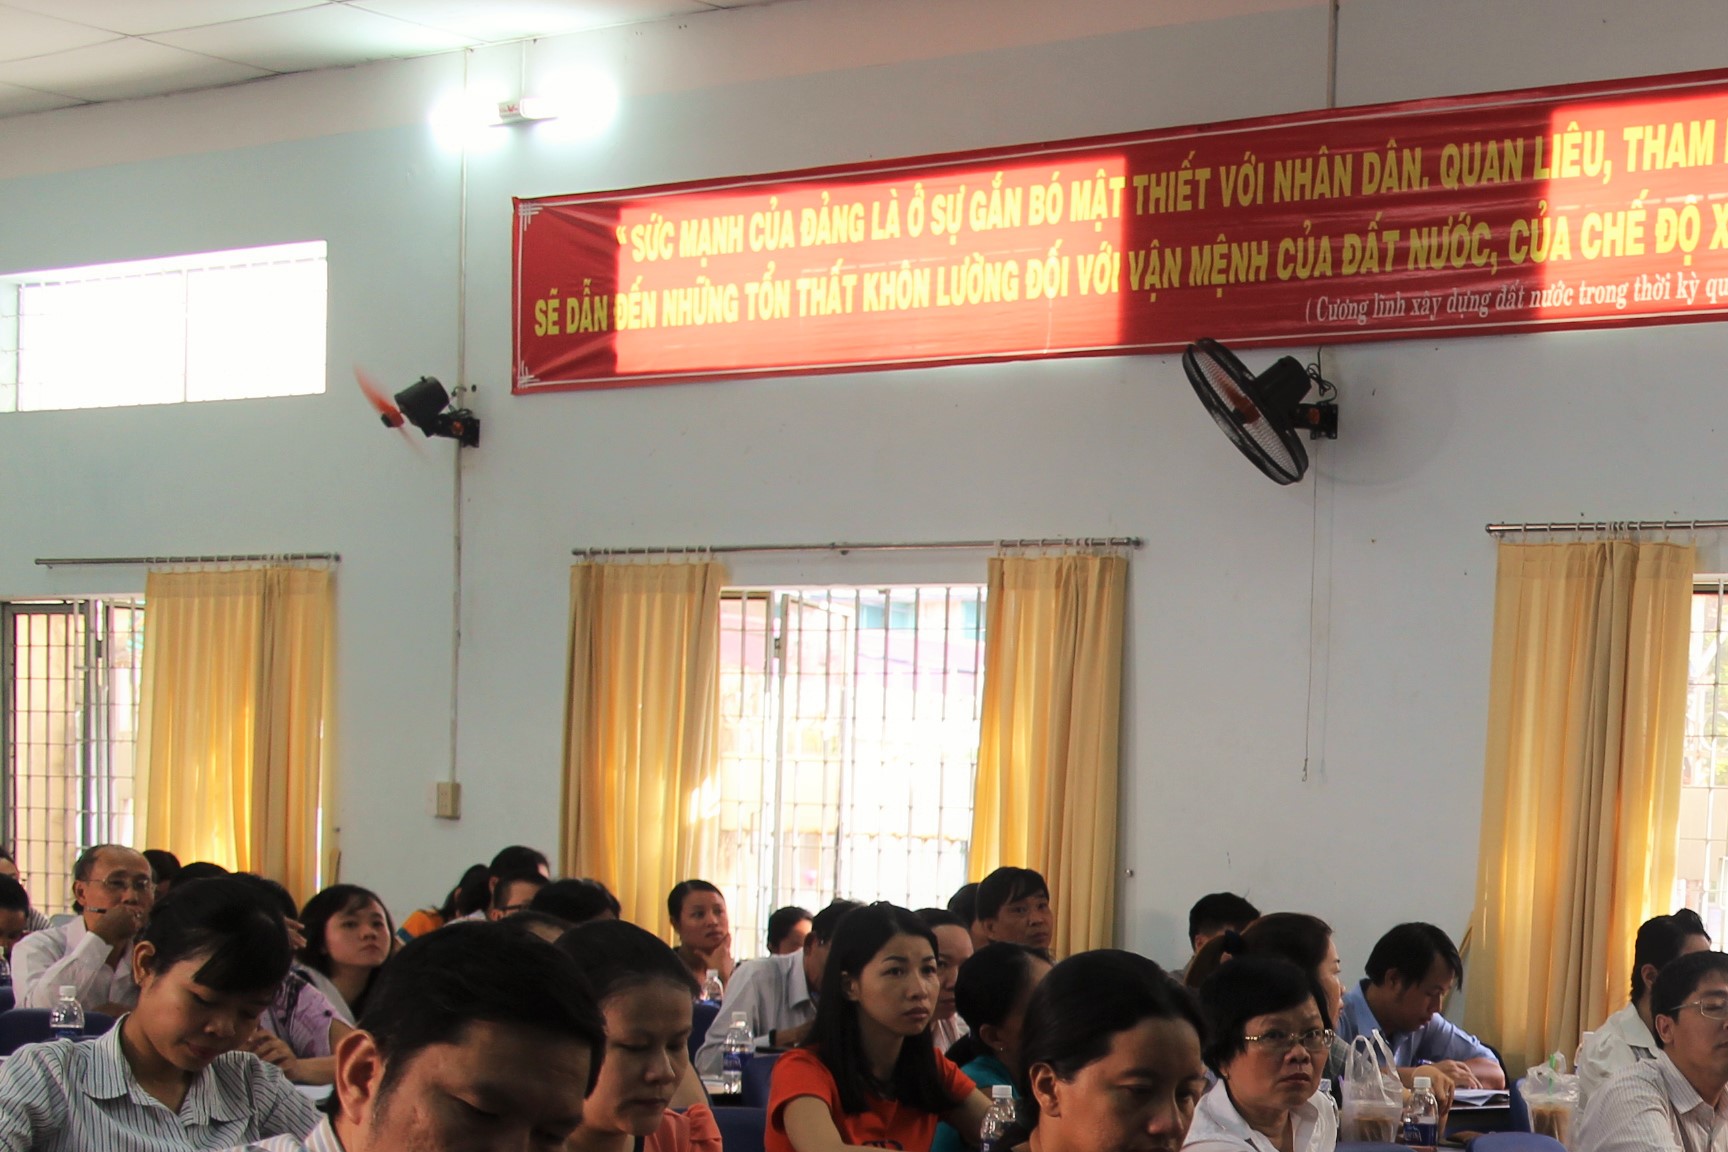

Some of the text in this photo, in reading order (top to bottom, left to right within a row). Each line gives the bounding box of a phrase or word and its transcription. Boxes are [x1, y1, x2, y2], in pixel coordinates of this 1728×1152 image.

[534, 288, 560, 337] SẼ
[566, 278, 608, 334] DẪN
[745, 261, 791, 321] TỔN
[796, 258, 858, 318] THẤT
[936, 252, 1019, 307] LƯỜNG
[1025, 240, 1068, 300] ĐỐI
[1077, 240, 1119, 296] VỚI
[1128, 239, 1183, 303] VẬN
[1189, 234, 1269, 297] MỆNH
[1276, 220, 1333, 281] CỦA
[1341, 211, 1400, 275] ĐẤT
[1509, 200, 1572, 265] CỦA
[1580, 189, 1649, 261] CHẾ
[1655, 195, 1701, 266] ĐỘ
[679, 214, 743, 268] MẠNH
[749, 196, 795, 252] CỦA
[800, 191, 865, 247] ĐẢNG
[871, 188, 901, 240] LÀ
[907, 182, 925, 238] Ở
[930, 184, 966, 246] SỰ
[969, 171, 1023, 232] GẮN
[1029, 171, 1069, 226] BÓ
[1070, 169, 1125, 232] MẬT
[1133, 151, 1211, 215] THIẾT
[1219, 151, 1264, 207] VỚI
[1274, 145, 1352, 203] NHÂN
[1440, 137, 1524, 191] QUAN
[1623, 118, 1715, 173] THAM
[1372, 291, 1406, 318] lĩnh
[1410, 290, 1442, 321] xây
[1579, 284, 1628, 309] trong
[1634, 273, 1671, 302] thời
[1676, 273, 1700, 302] kỳ
